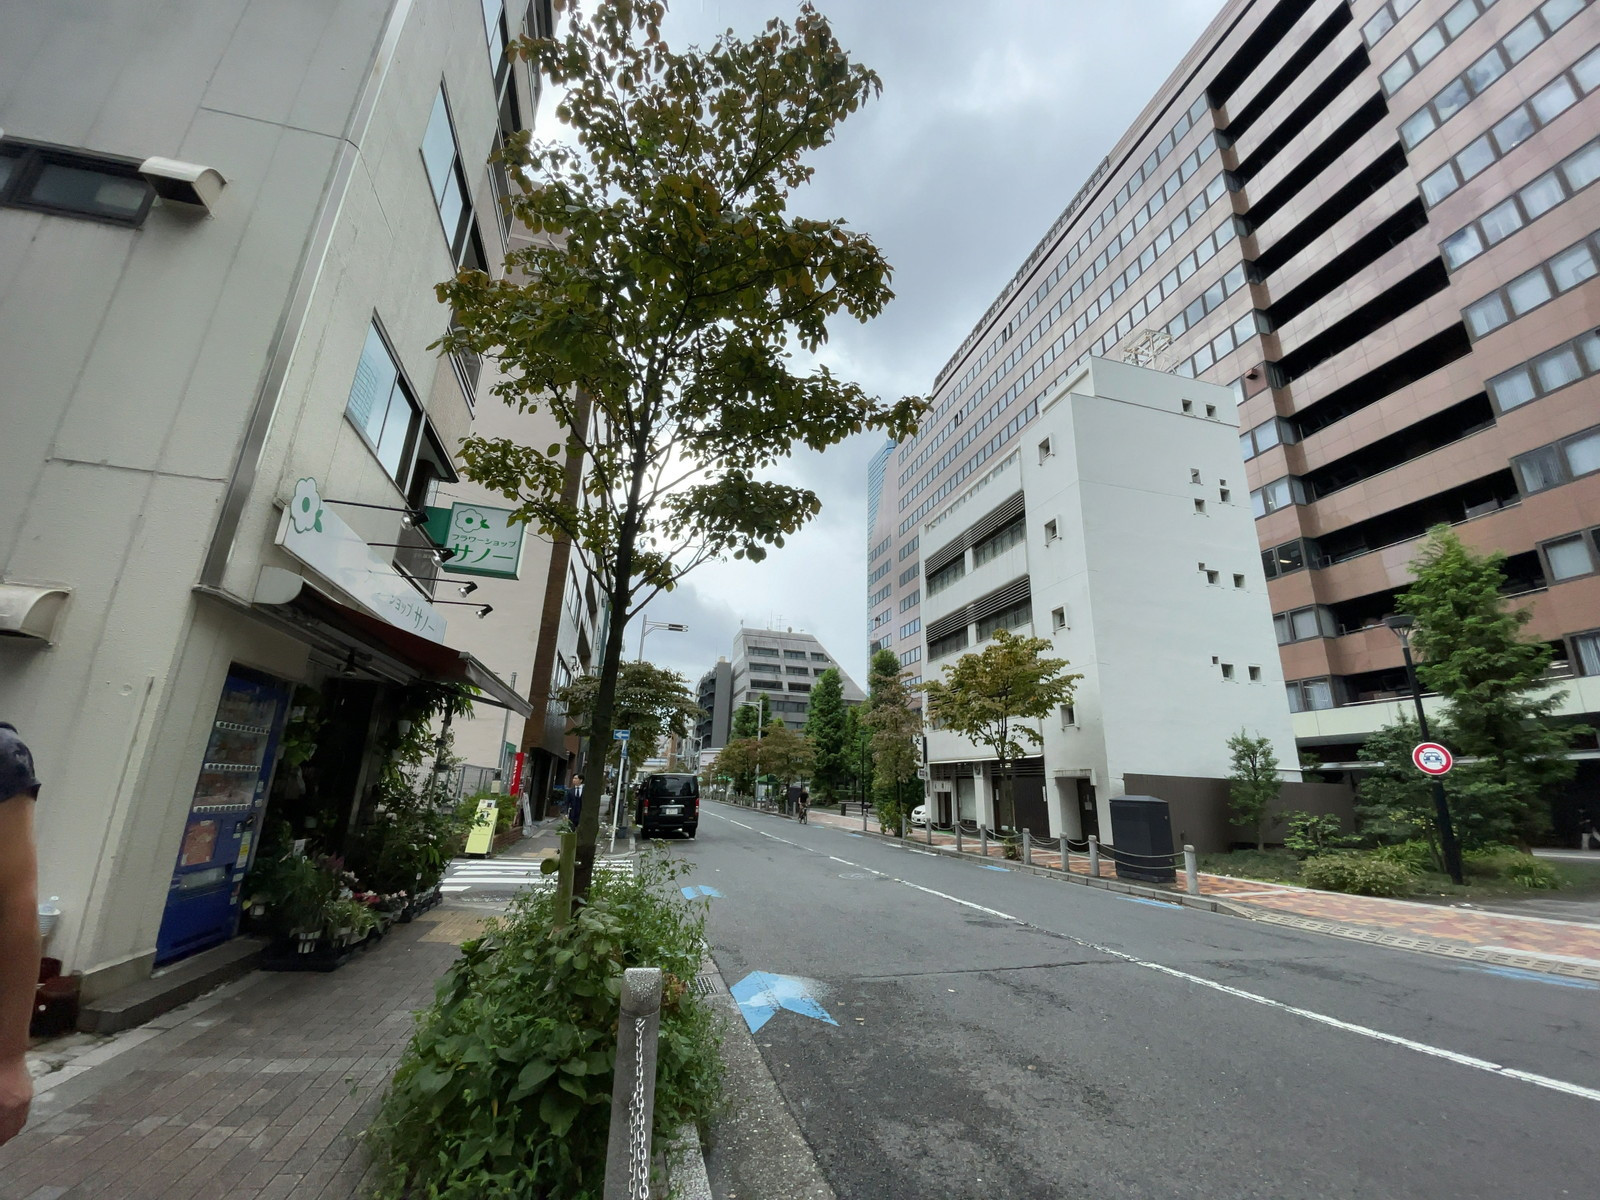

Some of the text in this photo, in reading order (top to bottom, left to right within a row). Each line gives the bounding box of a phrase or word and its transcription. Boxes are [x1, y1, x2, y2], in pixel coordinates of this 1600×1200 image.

[452, 534, 518, 548] フラワーショップ
[450, 543, 514, 564] サノー
